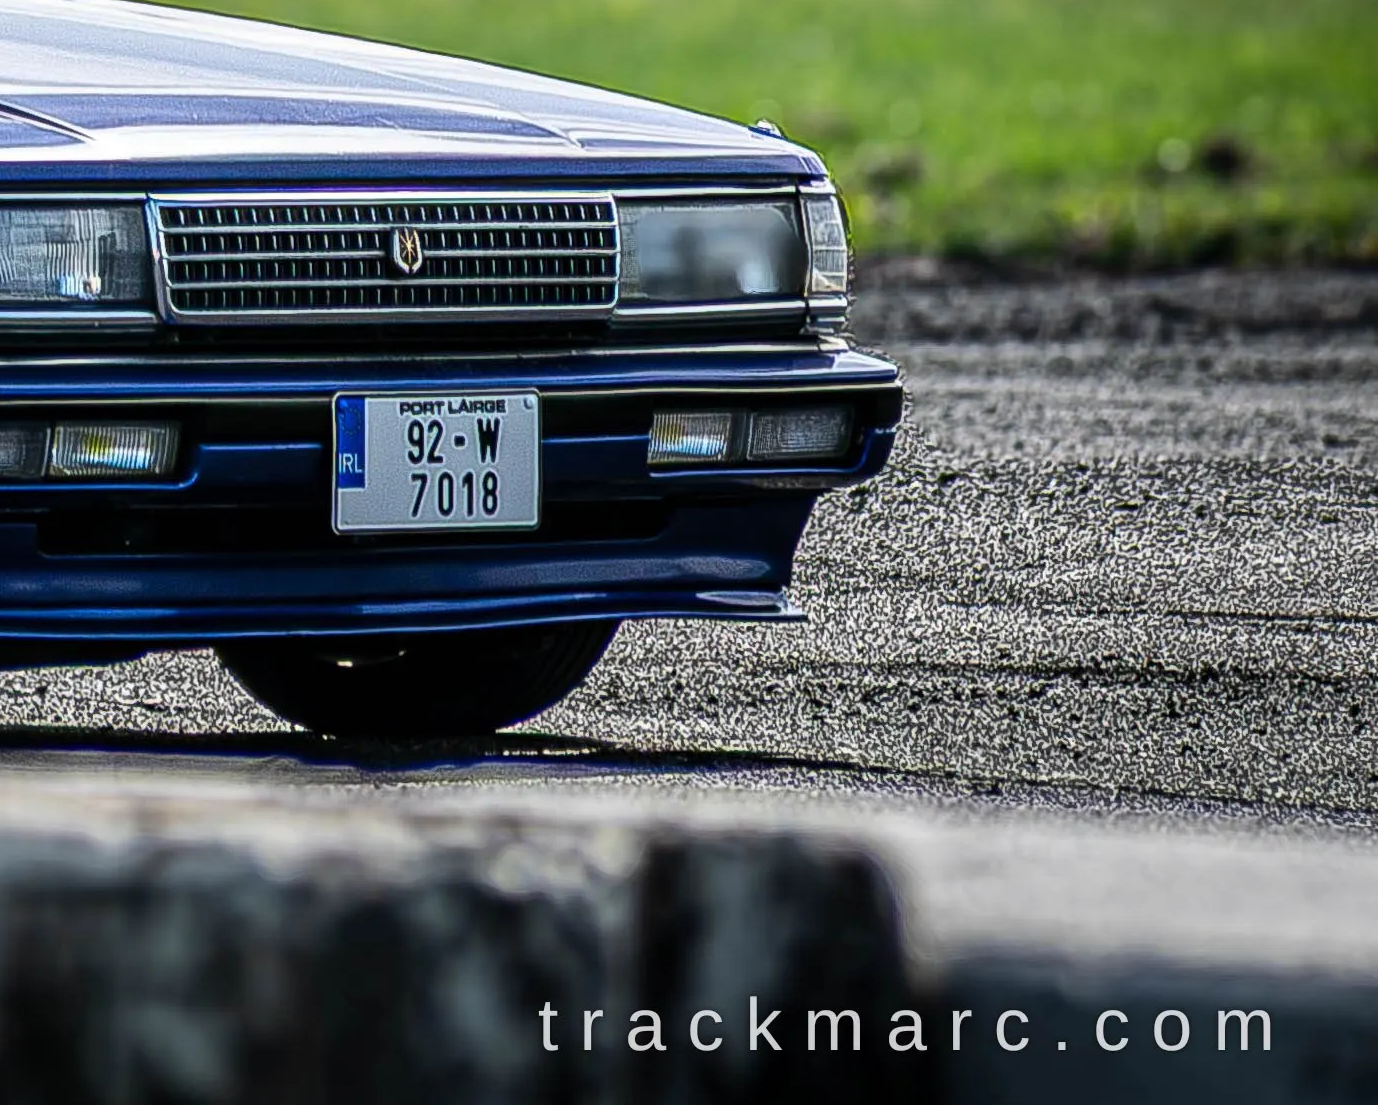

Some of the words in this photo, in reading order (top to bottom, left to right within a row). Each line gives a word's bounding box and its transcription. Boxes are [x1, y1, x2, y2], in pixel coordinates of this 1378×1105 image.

[399, 401, 445, 416] PORT
[338, 452, 364, 474] IRL
[410, 471, 499, 518] 7018
